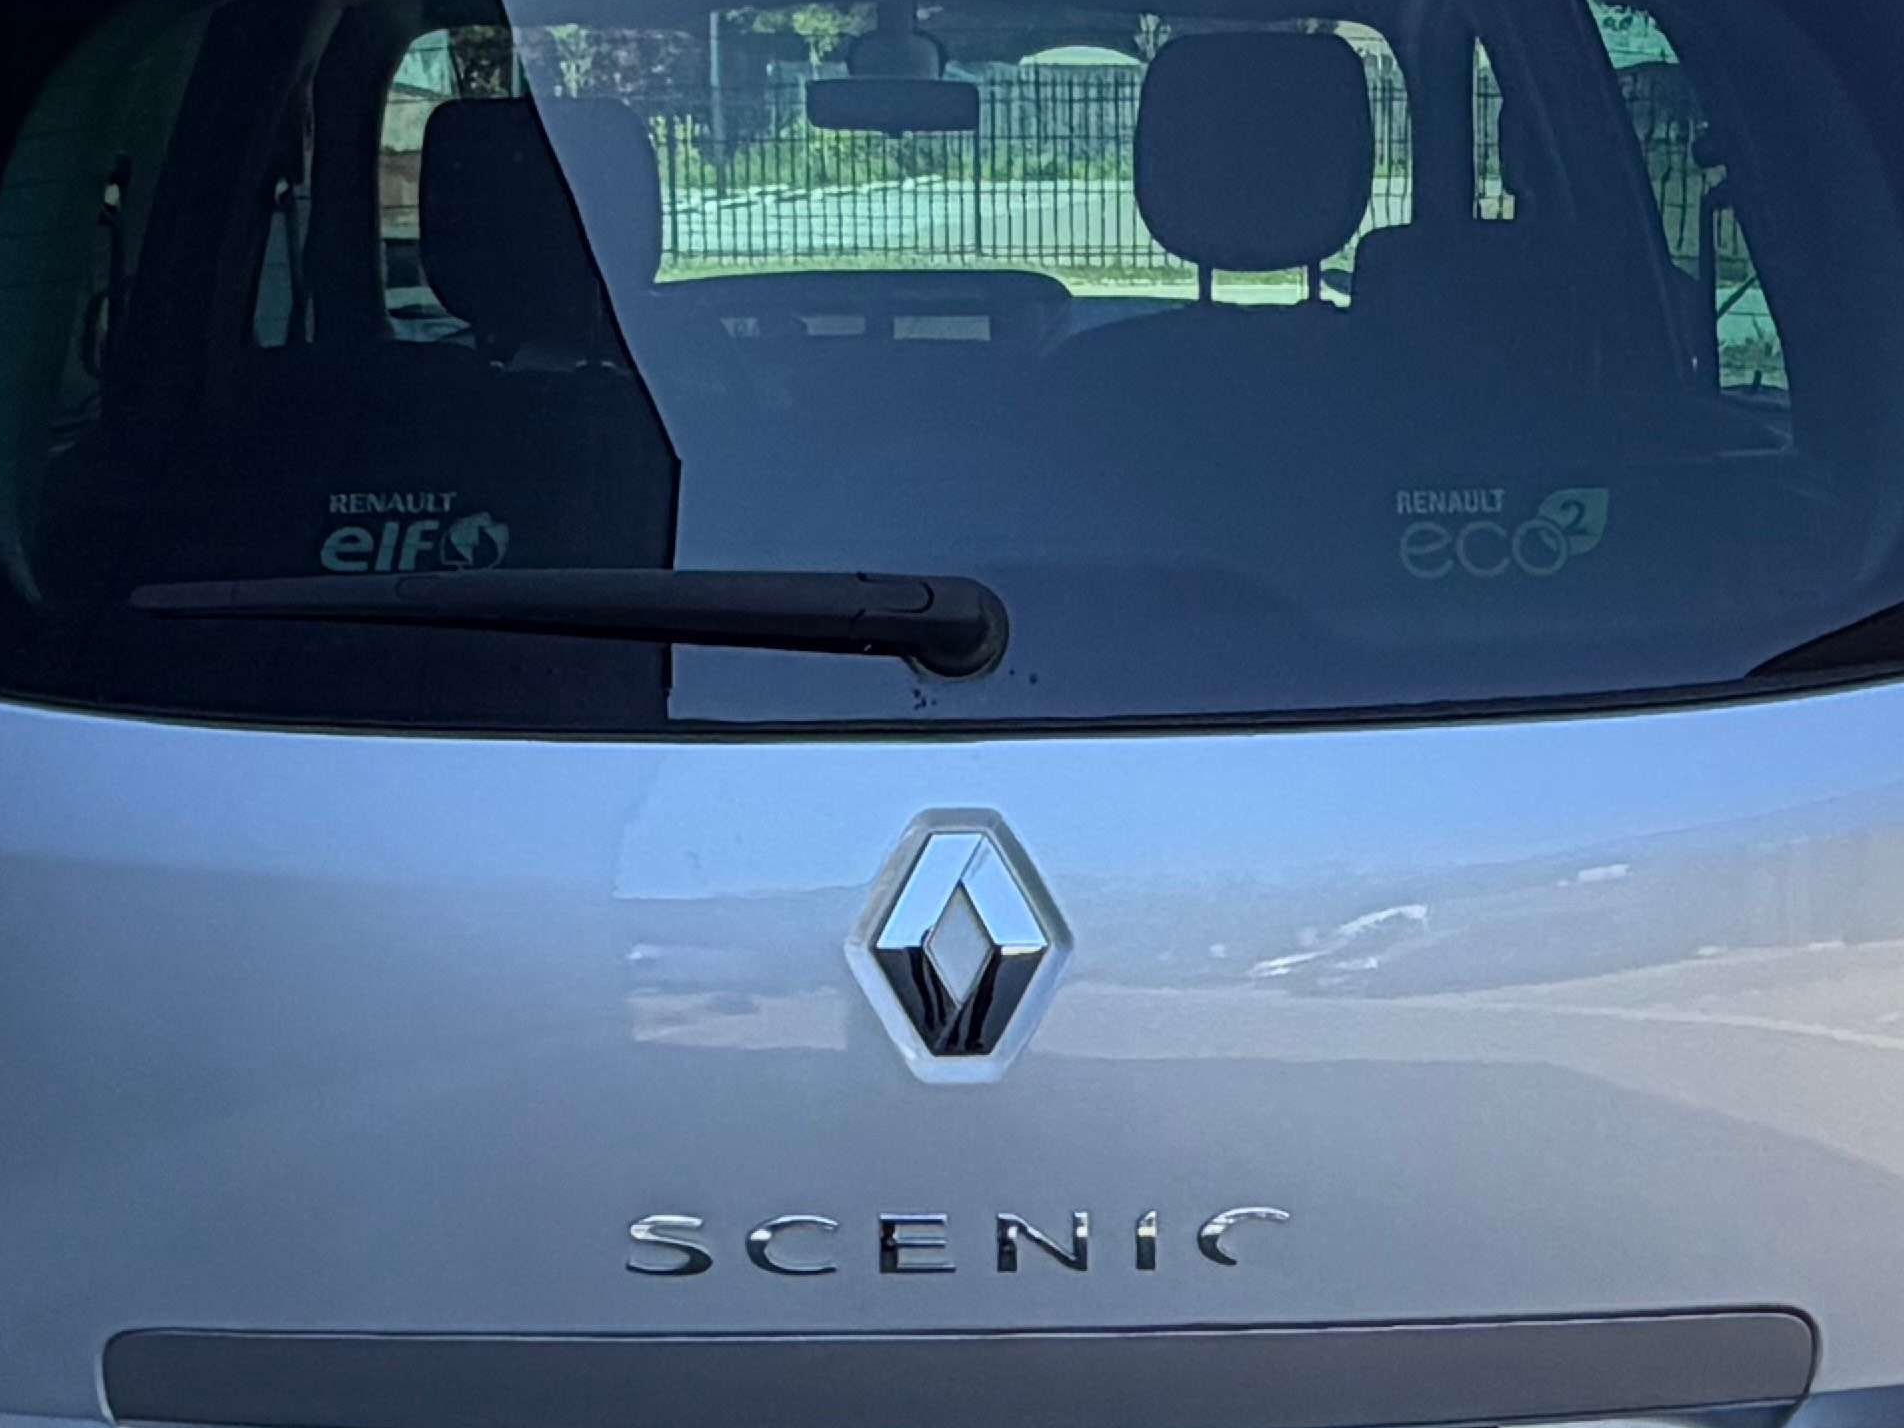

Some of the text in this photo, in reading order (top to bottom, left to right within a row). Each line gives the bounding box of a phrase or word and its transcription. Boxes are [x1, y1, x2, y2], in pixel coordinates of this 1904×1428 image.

[329, 491, 458, 514] RENAULT
[1396, 489, 1506, 514] RENAULT
[320, 520, 440, 571] elf
[626, 1206, 1291, 1275] SCENIC
